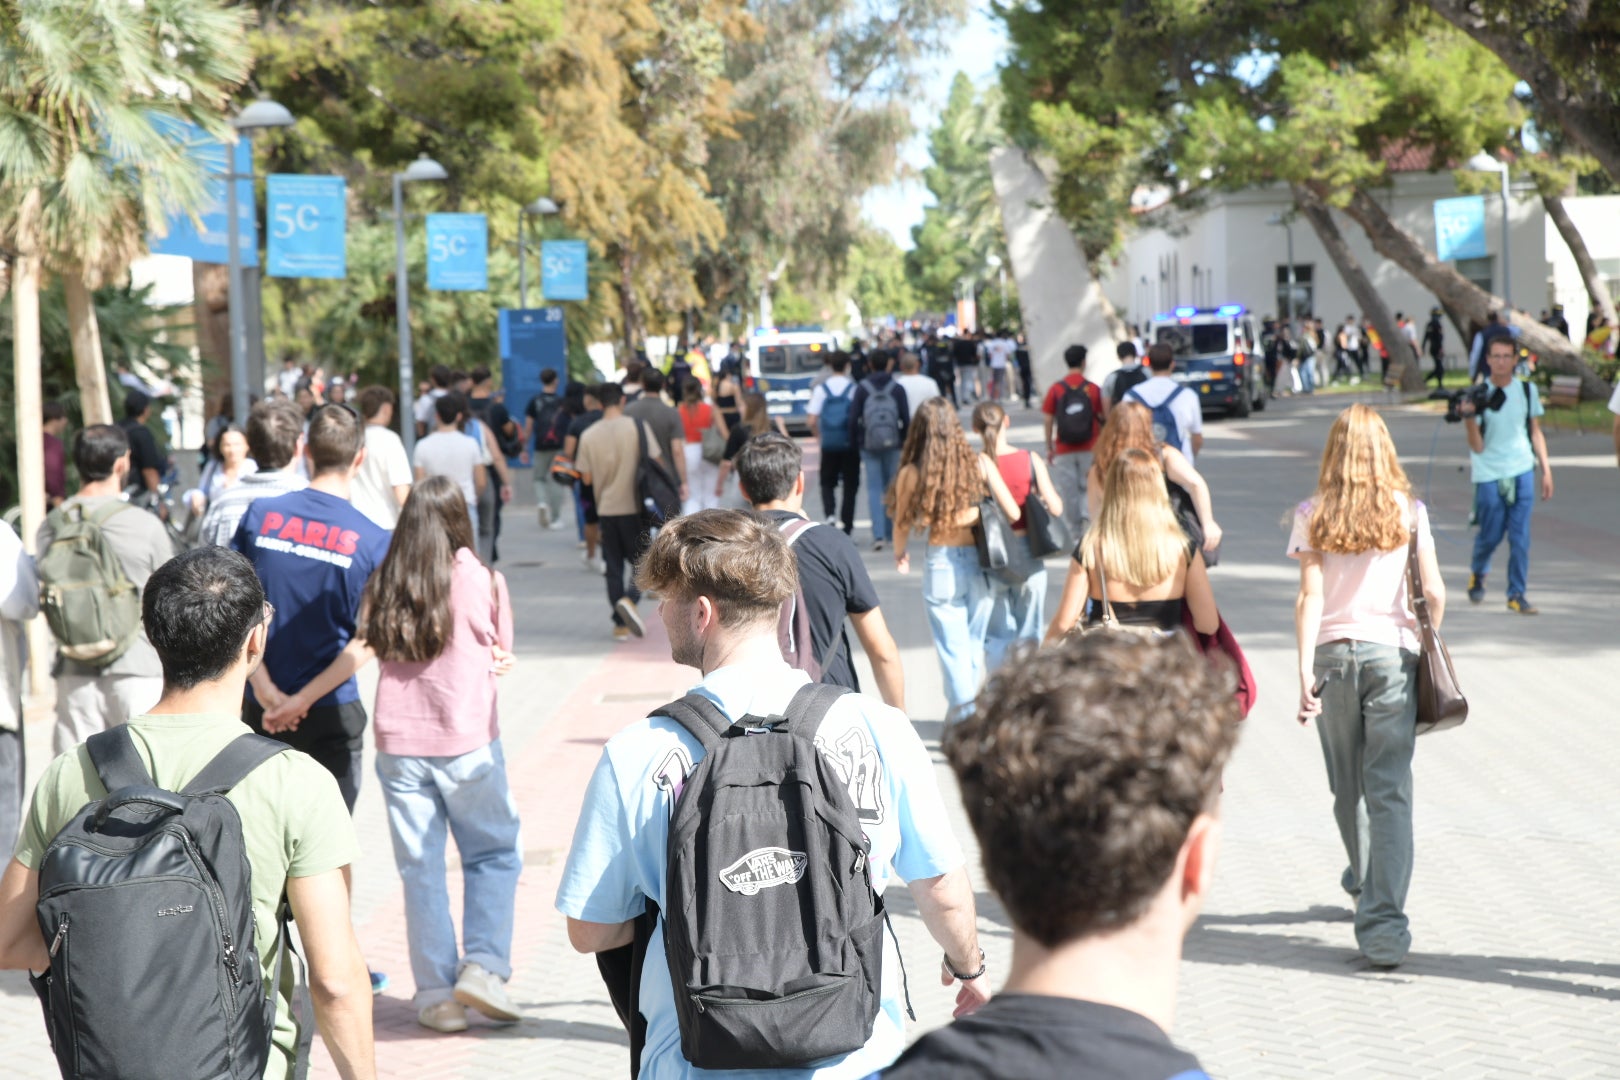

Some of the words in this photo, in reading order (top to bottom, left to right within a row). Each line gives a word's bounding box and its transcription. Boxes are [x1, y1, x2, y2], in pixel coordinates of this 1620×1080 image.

[262, 512, 360, 555] PARIS
[745, 852, 777, 873] VANS
[752, 862, 776, 881] THE
